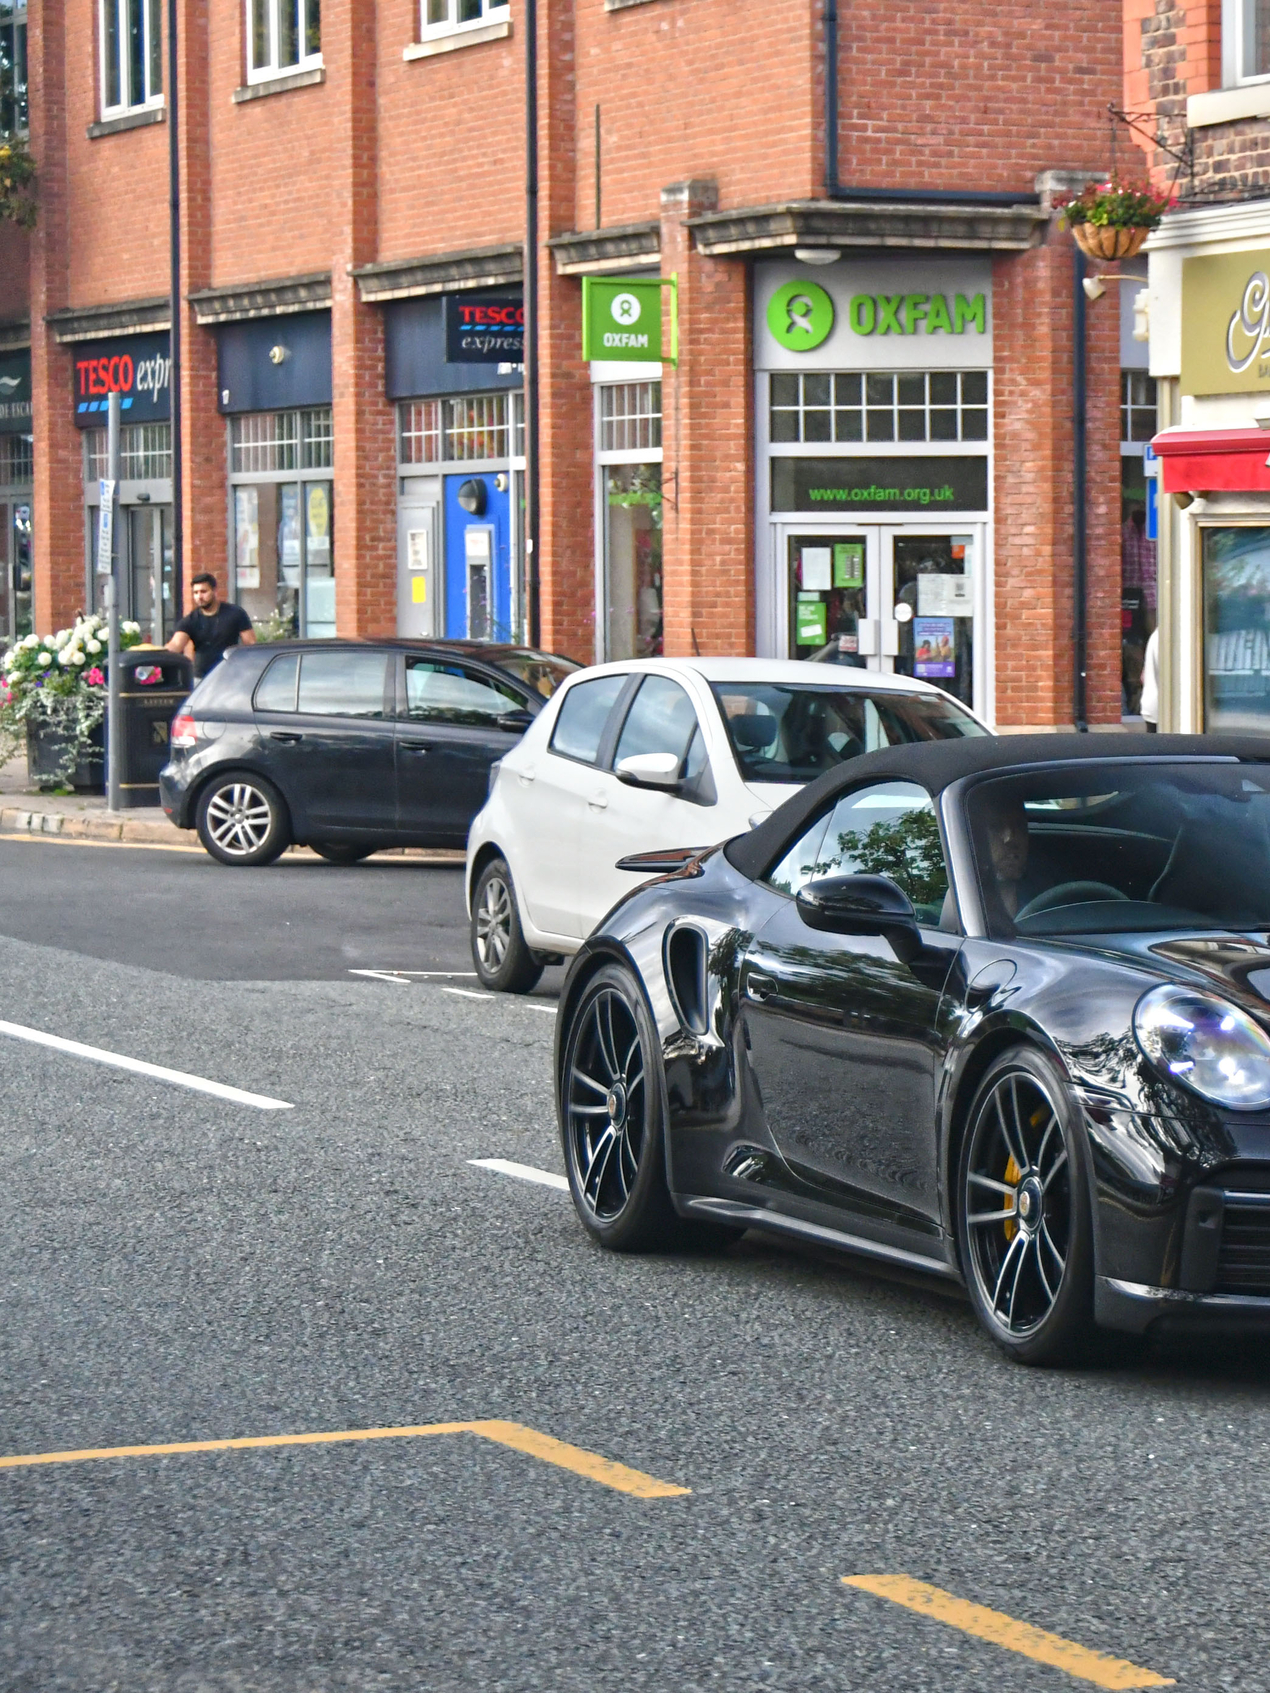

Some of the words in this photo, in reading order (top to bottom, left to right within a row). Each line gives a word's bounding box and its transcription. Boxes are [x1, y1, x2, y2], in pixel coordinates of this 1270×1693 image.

[849, 293, 986, 335] OXFAM
[603, 332, 649, 348] OXFAM
[76, 354, 134, 395] TESCO
[808, 485, 954, 504] www.oxfam.org.uk
